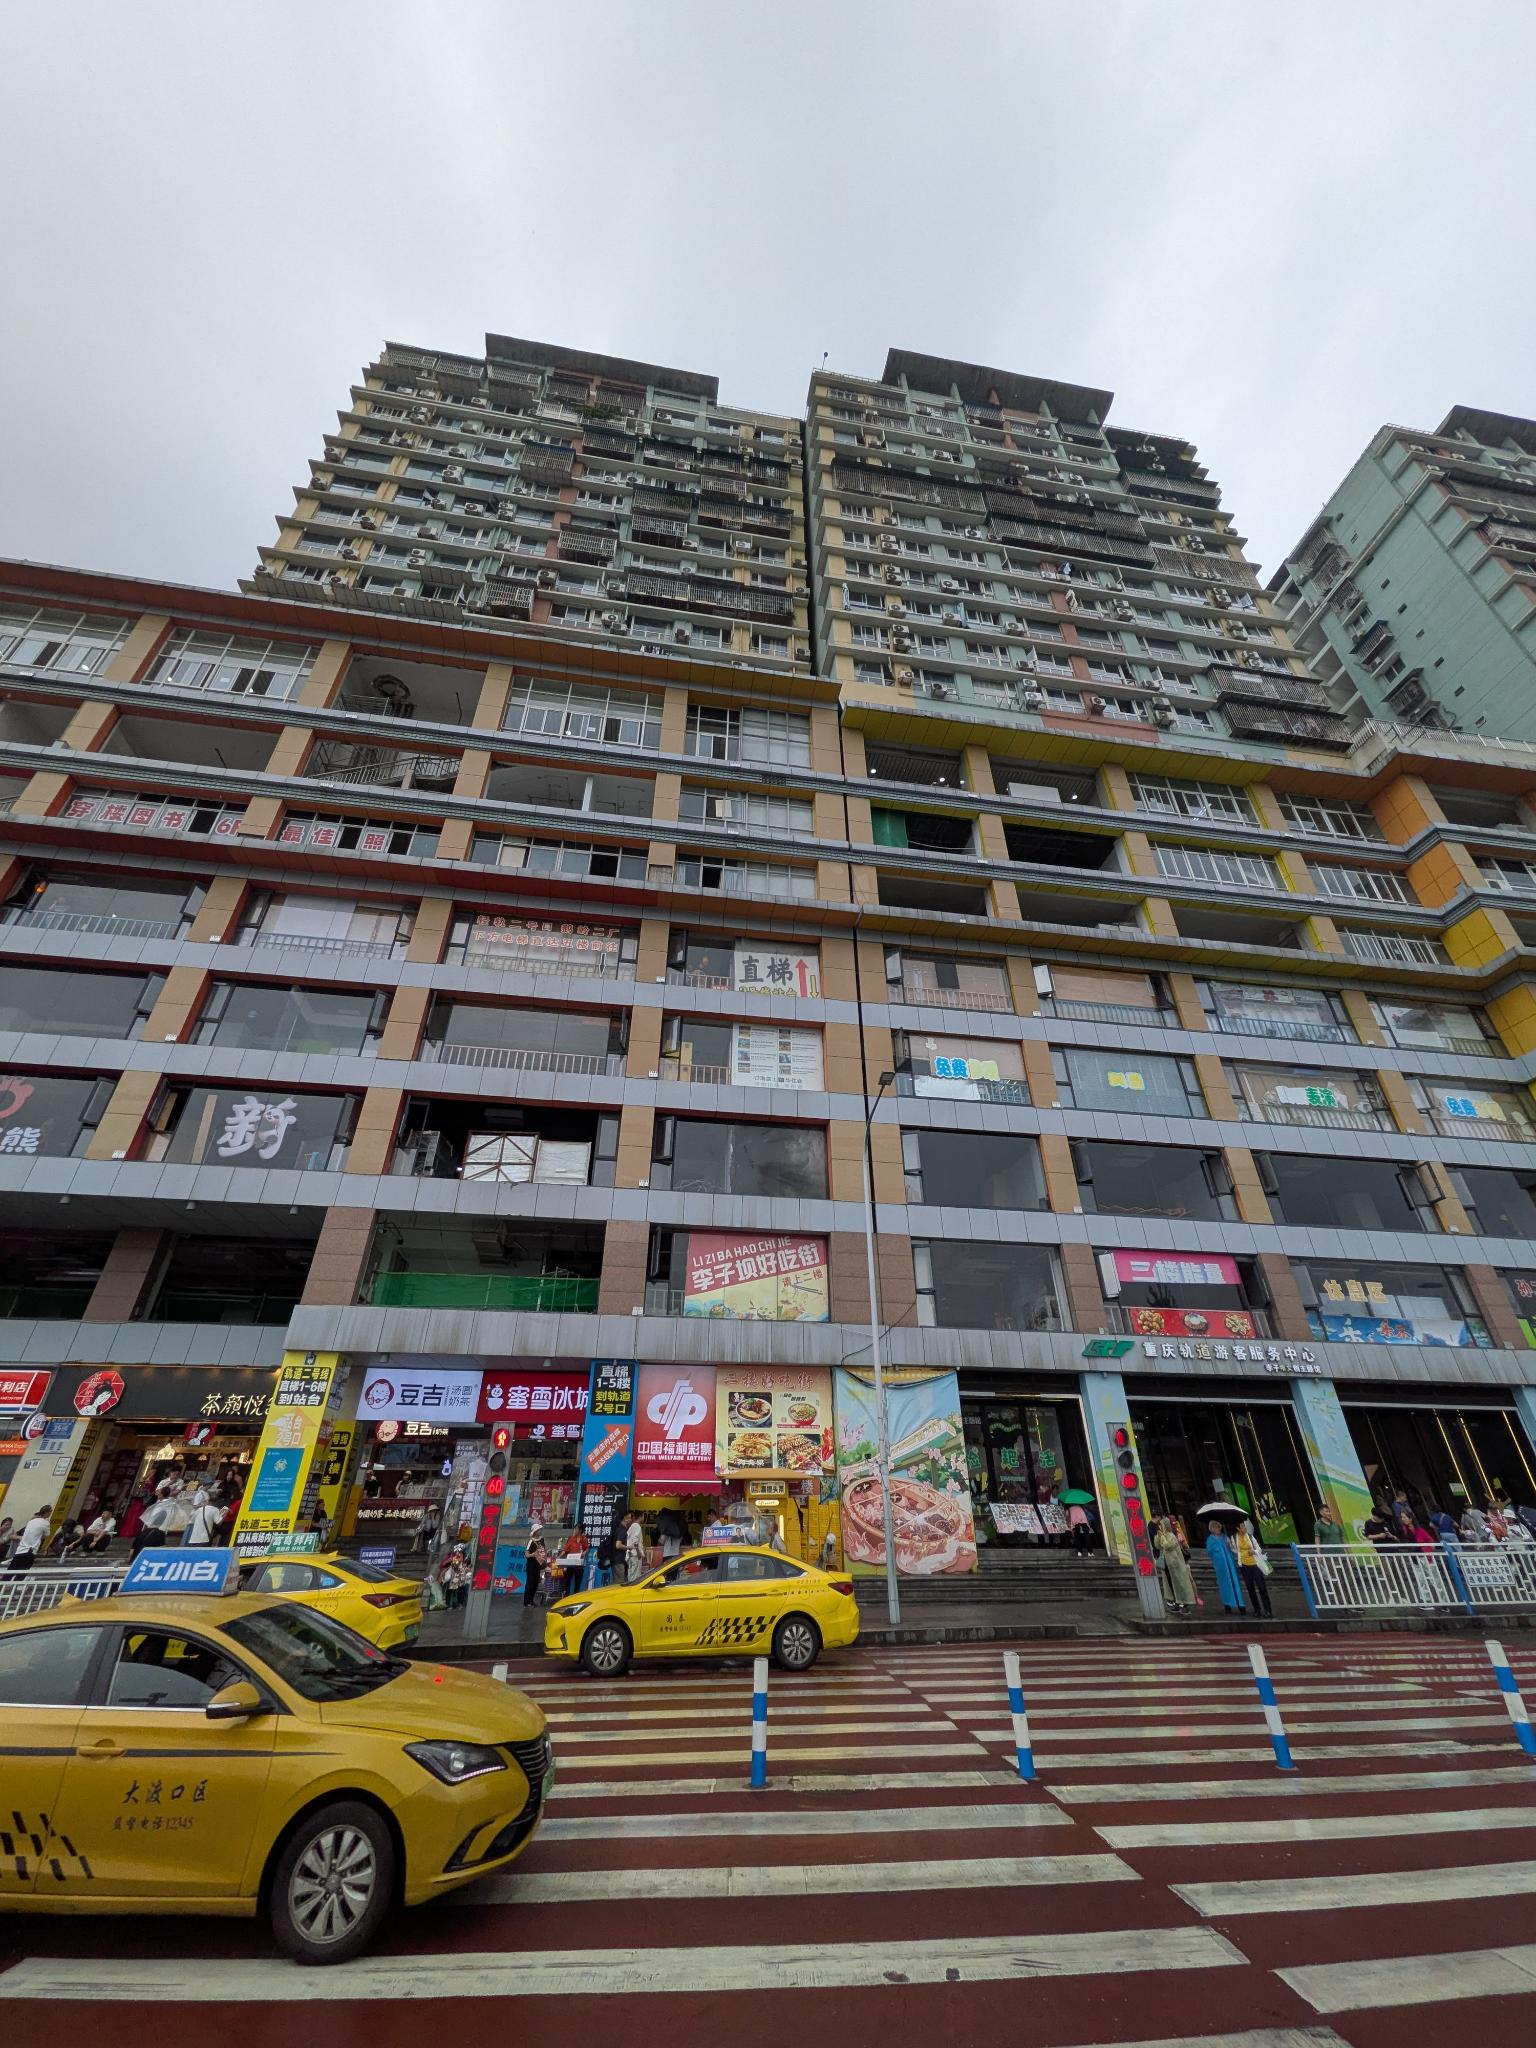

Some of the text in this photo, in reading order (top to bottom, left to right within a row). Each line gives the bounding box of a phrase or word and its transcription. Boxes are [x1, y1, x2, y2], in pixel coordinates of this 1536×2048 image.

[66, 799, 188, 829] 穿楼图书
[281, 824, 337, 847] 最佳
[362, 829, 386, 852] 照
[473, 930, 618, 953] 下方电梯直达五楼前往
[739, 955, 794, 986] 直梯
[935, 1056, 969, 1080] 免费
[1446, 1095, 1479, 1118] 免费
[0, 1126, 41, 1153] 熊
[693, 1235, 792, 1267] LI ZI BA HAO CHI JIE
[692, 1243, 820, 1290] 李子坝好吃街
[782, 1269, 824, 1287] 请上二楼
[1323, 1279, 1390, 1303] 休息区
[1142, 1341, 1317, 1363] 重庆轨道游客服务中心
[284, 1368, 330, 1380] 轨道二号线
[601, 1365, 629, 1377] 直梯
[0, 1381, 28, 1393] 利店
[279, 1380, 328, 1393] 直梯1-6楼
[597, 1377, 631, 1389] 1-5楼
[277, 1393, 321, 1406] 到站台
[396, 1383, 446, 1407] 豆吉
[596, 1391, 631, 1401] 到轨道
[595, 1403, 626, 1414] 2号口
[551, 1424, 584, 1437] 蜜雪
[637, 1441, 712, 1455] 中国福利彩票
[486, 1479, 503, 1494] 60
[240, 1518, 290, 1530] 轨道二号线
[583, 1515, 612, 1525] 观音桥
[237, 1531, 284, 1544] 请从商场内
[132, 1559, 219, 1582] 江小白
[121, 1779, 209, 1804] 大渡口区
